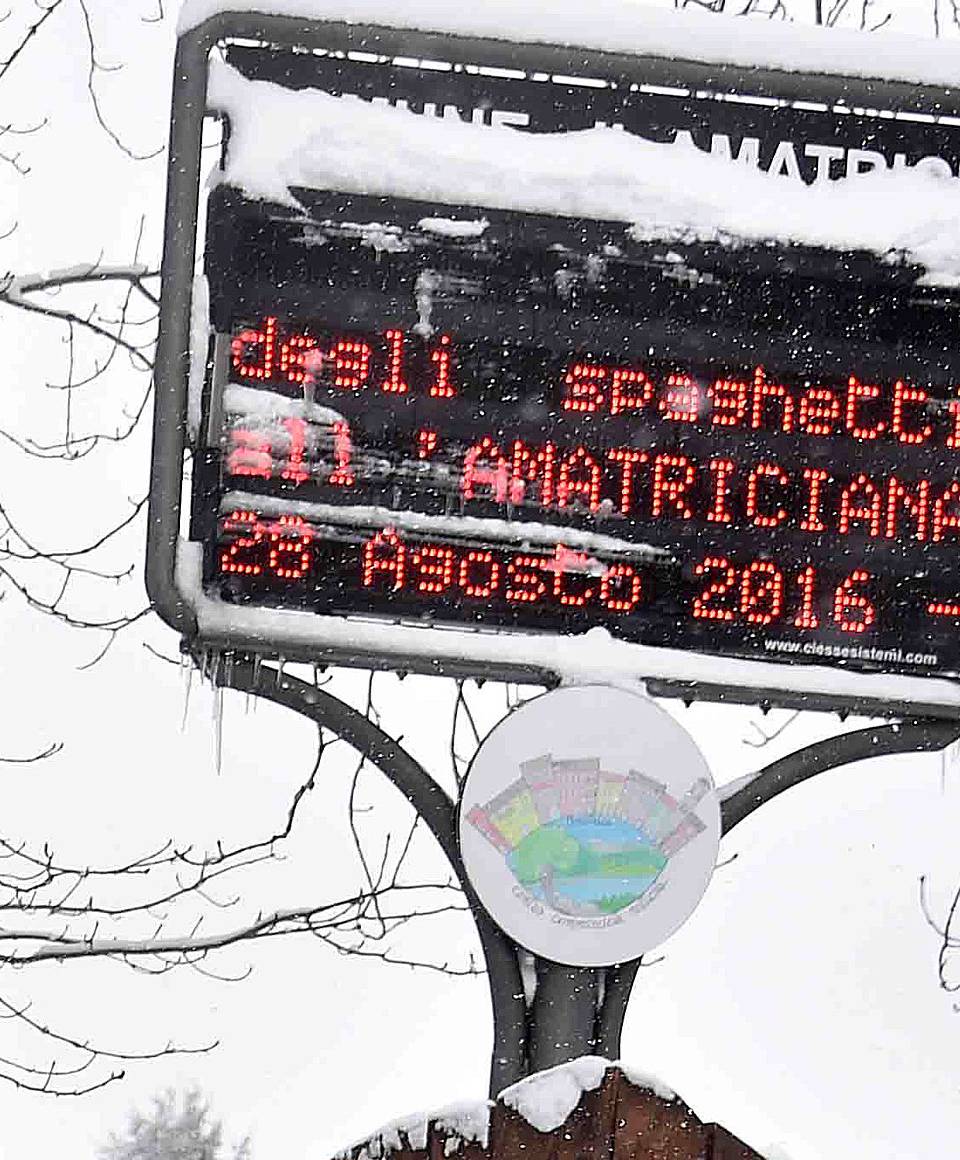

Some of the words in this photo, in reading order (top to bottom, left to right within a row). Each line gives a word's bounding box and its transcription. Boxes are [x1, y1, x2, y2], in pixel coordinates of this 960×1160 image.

[230, 316, 455, 398] degli
[220, 509, 314, 579] 28
[362, 527, 642, 612] Agosto
[691, 556, 876, 633] 2016
